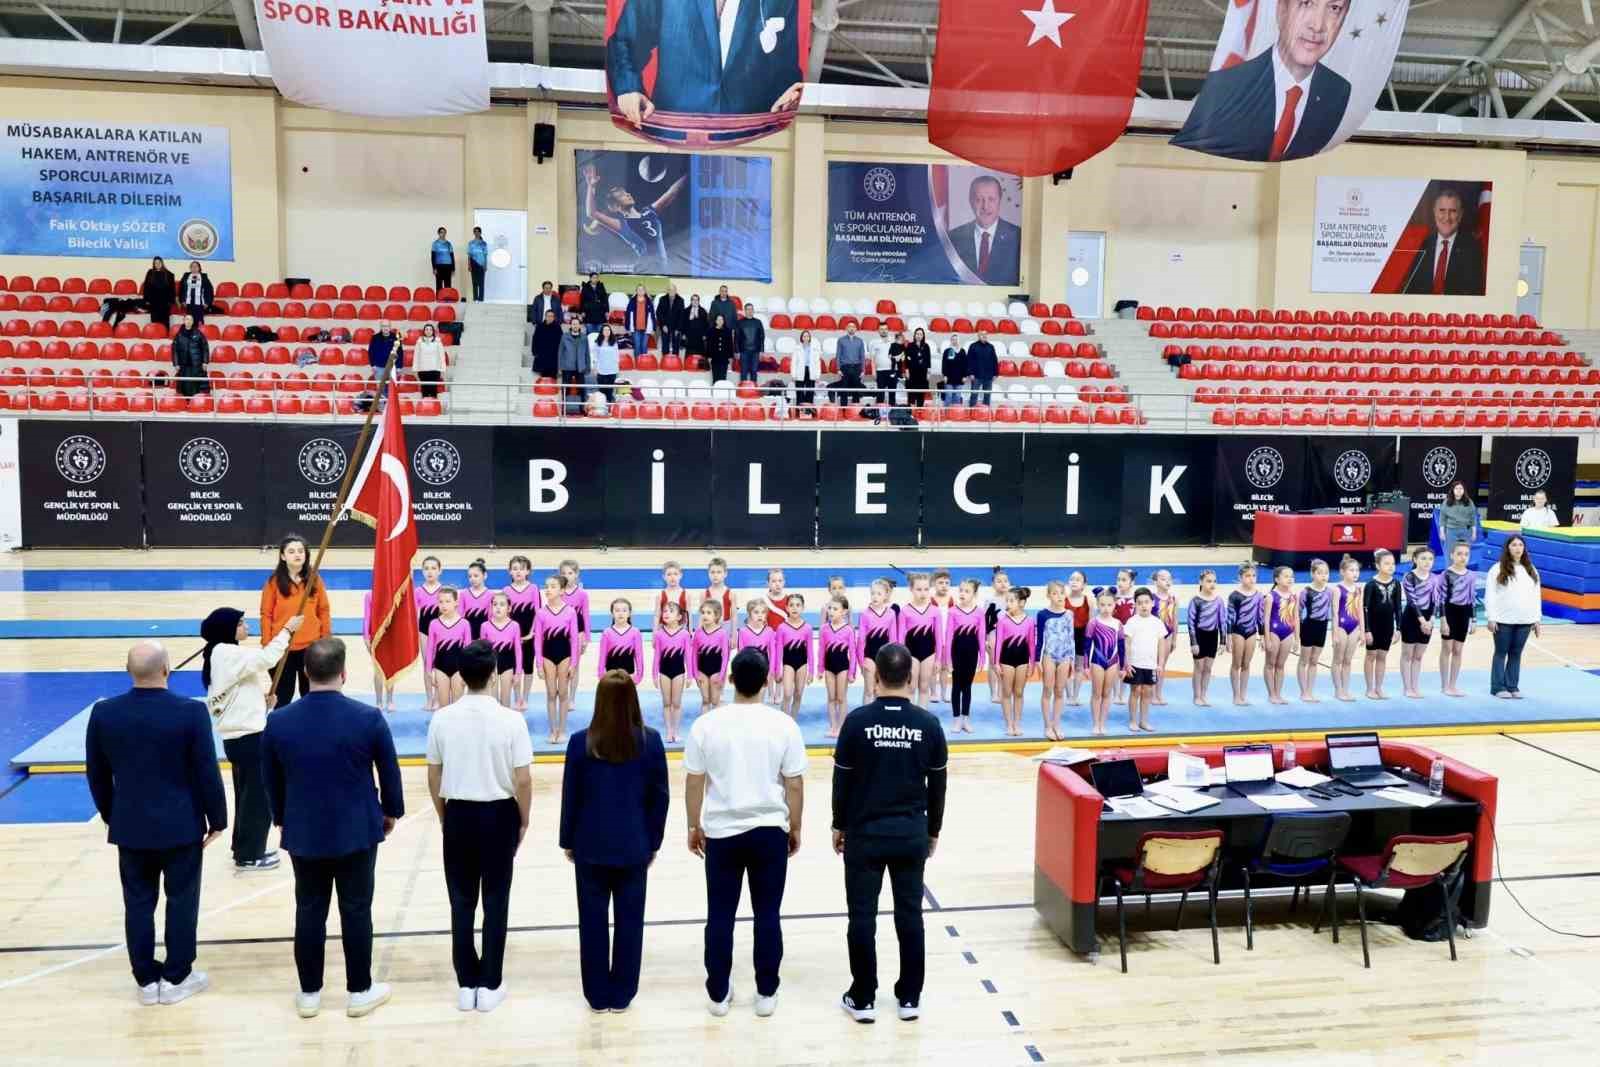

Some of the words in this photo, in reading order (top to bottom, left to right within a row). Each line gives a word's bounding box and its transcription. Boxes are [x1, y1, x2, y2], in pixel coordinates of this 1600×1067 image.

[263, 0, 331, 28] SPOR
[338, 9, 476, 36] BAKANLIĞI
[7, 123, 135, 142] MÜSABAKALARA
[139, 130, 203, 144] KATILAN
[21, 147, 82, 163] HAKEM,
[85, 148, 168, 165] ANTRENÖR
[171, 152, 190, 165] VE
[39, 169, 174, 186] SPORCULARIMIZA
[32, 191, 117, 207] BAŞARILAR
[120, 191, 183, 208] DİLERİM
[844, 210, 865, 220] TÜM
[867, 211, 917, 222] ANTRENÖR
[49, 218, 78, 232] Faik
[80, 219, 120, 234] Oktay
[122, 219, 167, 233] SÖZER
[641, 220, 657, 238] 3
[834, 223, 845, 232] VE
[847, 223, 926, 234] SPORCULARIMIZA
[67, 236, 111, 249] Bilecik
[114, 237, 150, 250] Valisi
[66, 489, 97, 498] BİLECİK
[190, 490, 220, 499] BİLECİK
[423, 490, 451, 499] BİLECİK
[44, 500, 77, 511] GENÇLİK
[90, 502, 112, 510] SPOR
[113, 500, 120, 510] İL
[167, 500, 201, 511] GENÇLİK
[202, 502, 213, 510] VE
[213, 502, 235, 510] SPOR
[236, 501, 243, 510] İL
[287, 502, 319, 511] GENÇLİK
[56, 511, 108, 521] MÜDÜRLÜĞÜ
[180, 511, 232, 522] MÜDÜRLÜĞÜ
[864, 724, 923, 741] TÜRKİYE
